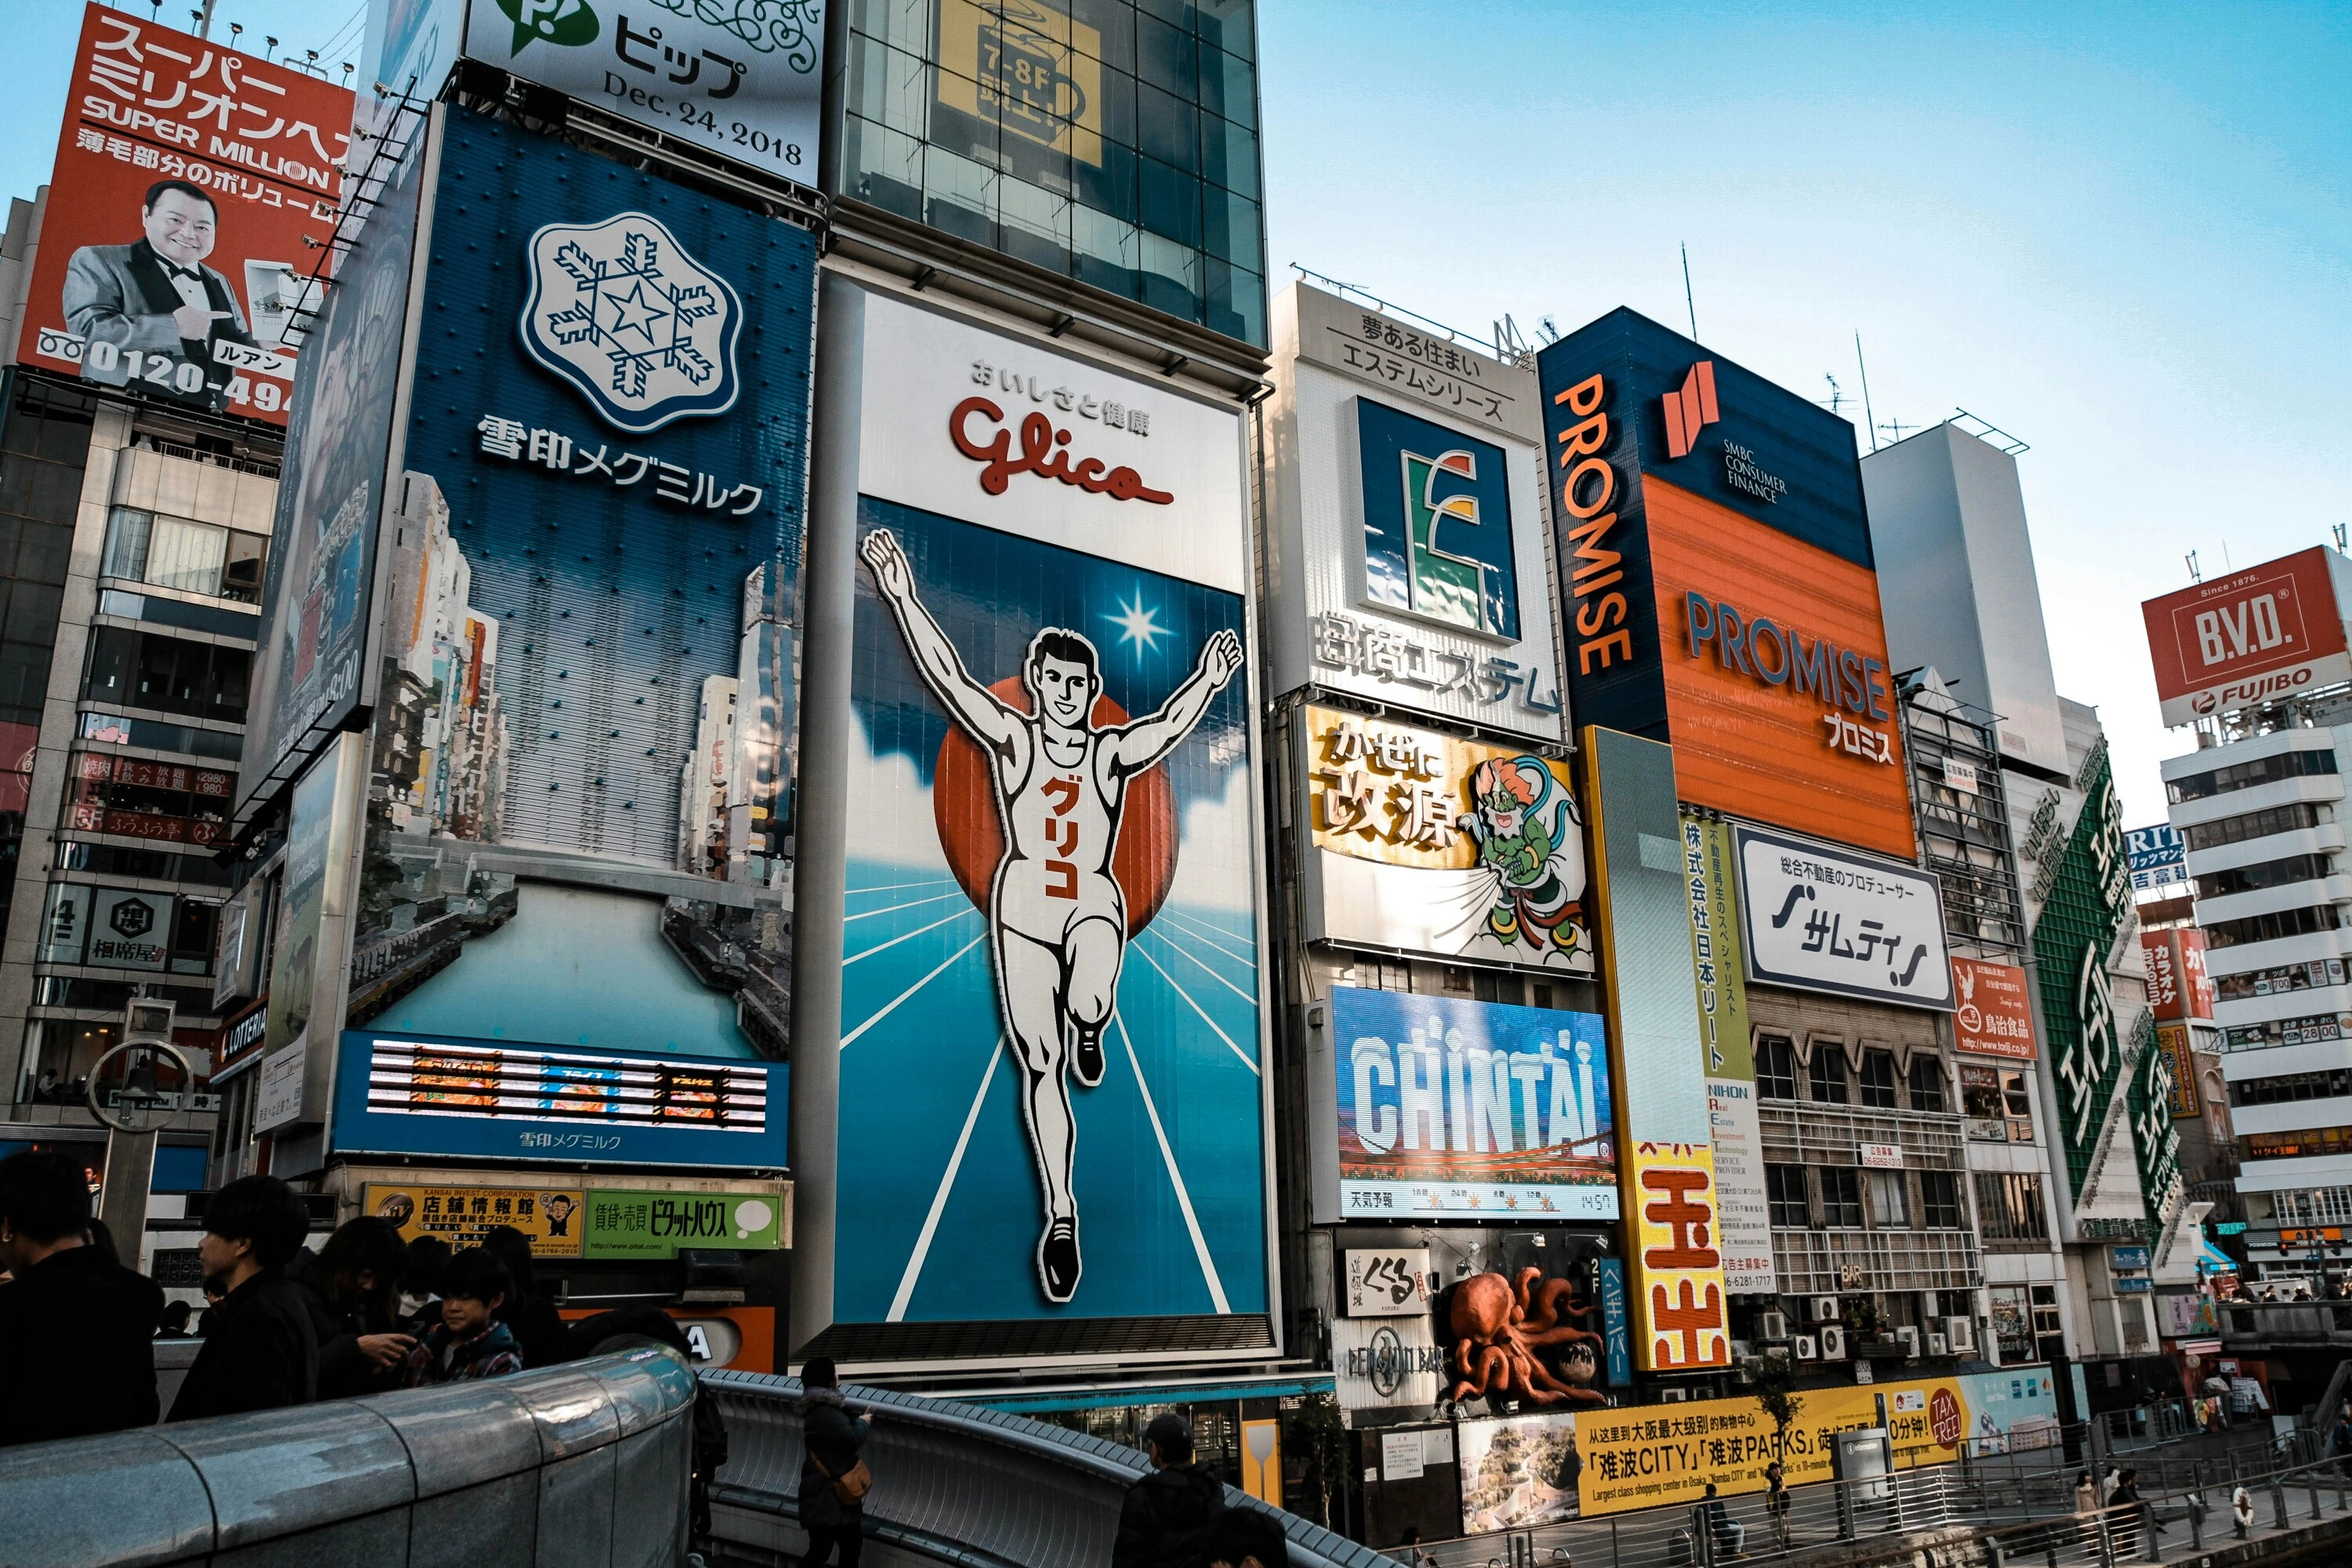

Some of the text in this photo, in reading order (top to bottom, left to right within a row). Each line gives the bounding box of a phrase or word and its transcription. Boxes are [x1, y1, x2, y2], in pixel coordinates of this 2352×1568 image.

[95, 16, 285, 97] スーパー
[615, 13, 747, 99] ピップ
[984, 42, 1052, 92] 7-8F
[604, 71, 803, 166] Dec. 24, 2018
[82, 95, 330, 189] SUPER MILLION
[220, 347, 284, 372] ルアン
[1361, 314, 1481, 377] 夢ある住まい
[972, 359, 1150, 437] おいしさと健康
[1343, 343, 1503, 423] エステムシリーズ
[477, 415, 762, 515] 雪印メグミルク
[949, 396, 1174, 505] Glico
[1724, 439, 1755, 465] SMBC
[1726, 456, 1788, 495] CONSUMER
[1728, 470, 1777, 504] FINANCE
[1554, 373, 1632, 676] PROMISE
[2201, 583, 2230, 597] Since
[2195, 593, 2293, 666] B.V.D.
[1317, 609, 1560, 713] 日商エステム
[1685, 591, 1889, 722] PROMISE
[2221, 668, 2312, 706] FUJIBO
[1329, 721, 1444, 777] かぜに
[1824, 713, 1896, 766] プロミス
[84, 758, 111, 779] 焼肉
[122, 771, 185, 790] 飲み放題
[123, 761, 185, 779] 食べ放題
[1319, 767, 1460, 848] 改源
[111, 818, 181, 840] ふうふう亭
[1040, 774, 1083, 900] グリコ
[1780, 855, 1915, 900] 総合不動産のプロデューサー
[1709, 829, 1736, 1018] 不動産再生のスペシャリスト
[1802, 908, 1901, 966] サムティ
[92, 938, 157, 963] 相席屋
[1686, 822, 1724, 1072] 株式会社日本リート
[2155, 945, 2177, 1004] カラオケ
[229, 1007, 267, 1054] LOTTERIA
[1985, 1014, 2029, 1039] 鳥治食品
[2060, 941, 2114, 1148] エイブル
[1352, 1021, 1600, 1157] CHINTAI
[1708, 1083, 1748, 1099] NIHON
[1709, 1098, 1728, 1112] Real
[1711, 1112, 1735, 1127] Estate
[1711, 1127, 1746, 1142] Investment
[520, 1132, 621, 1150] 雪印メグミルク
[1712, 1141, 1748, 1156] Technology
[1714, 1156, 1740, 1165] SERVICE
[1715, 1167, 1747, 1175] PROVIDER
[422, 1196, 535, 1215] 店舗情報館
[483, 1190, 535, 1199] CORPORATION
[1351, 1191, 1393, 1208] 天気予報
[421, 1214, 534, 1224] 居抜き店舗総合プロデュース
[651, 1199, 728, 1238] ピタットハウス
[1363, 1257, 1415, 1305] くくる
[1591, 1258, 1600, 1294] 2F
[1841, 1265, 1862, 1282] BAR
[1603, 1267, 1626, 1374] ペンギンバー
[1856, 1360, 1871, 1374] BAR
[1932, 1393, 1955, 1421] TAX
[1589, 1412, 1756, 1444] 从这里到大阪最大级别的购物中心
[1933, 1413, 1962, 1444] FREE!
[1593, 1488, 1617, 1503] Largest
[1617, 1486, 1634, 1498] class
[1635, 1481, 1661, 1497] shopping
[1663, 1479, 1681, 1491] center
[1682, 1477, 1688, 1488] in
[1747, 1468, 1757, 1479] and
[1796, 1461, 1802, 1471] is
[1802, 1458, 1828, 1471] 10-minute
